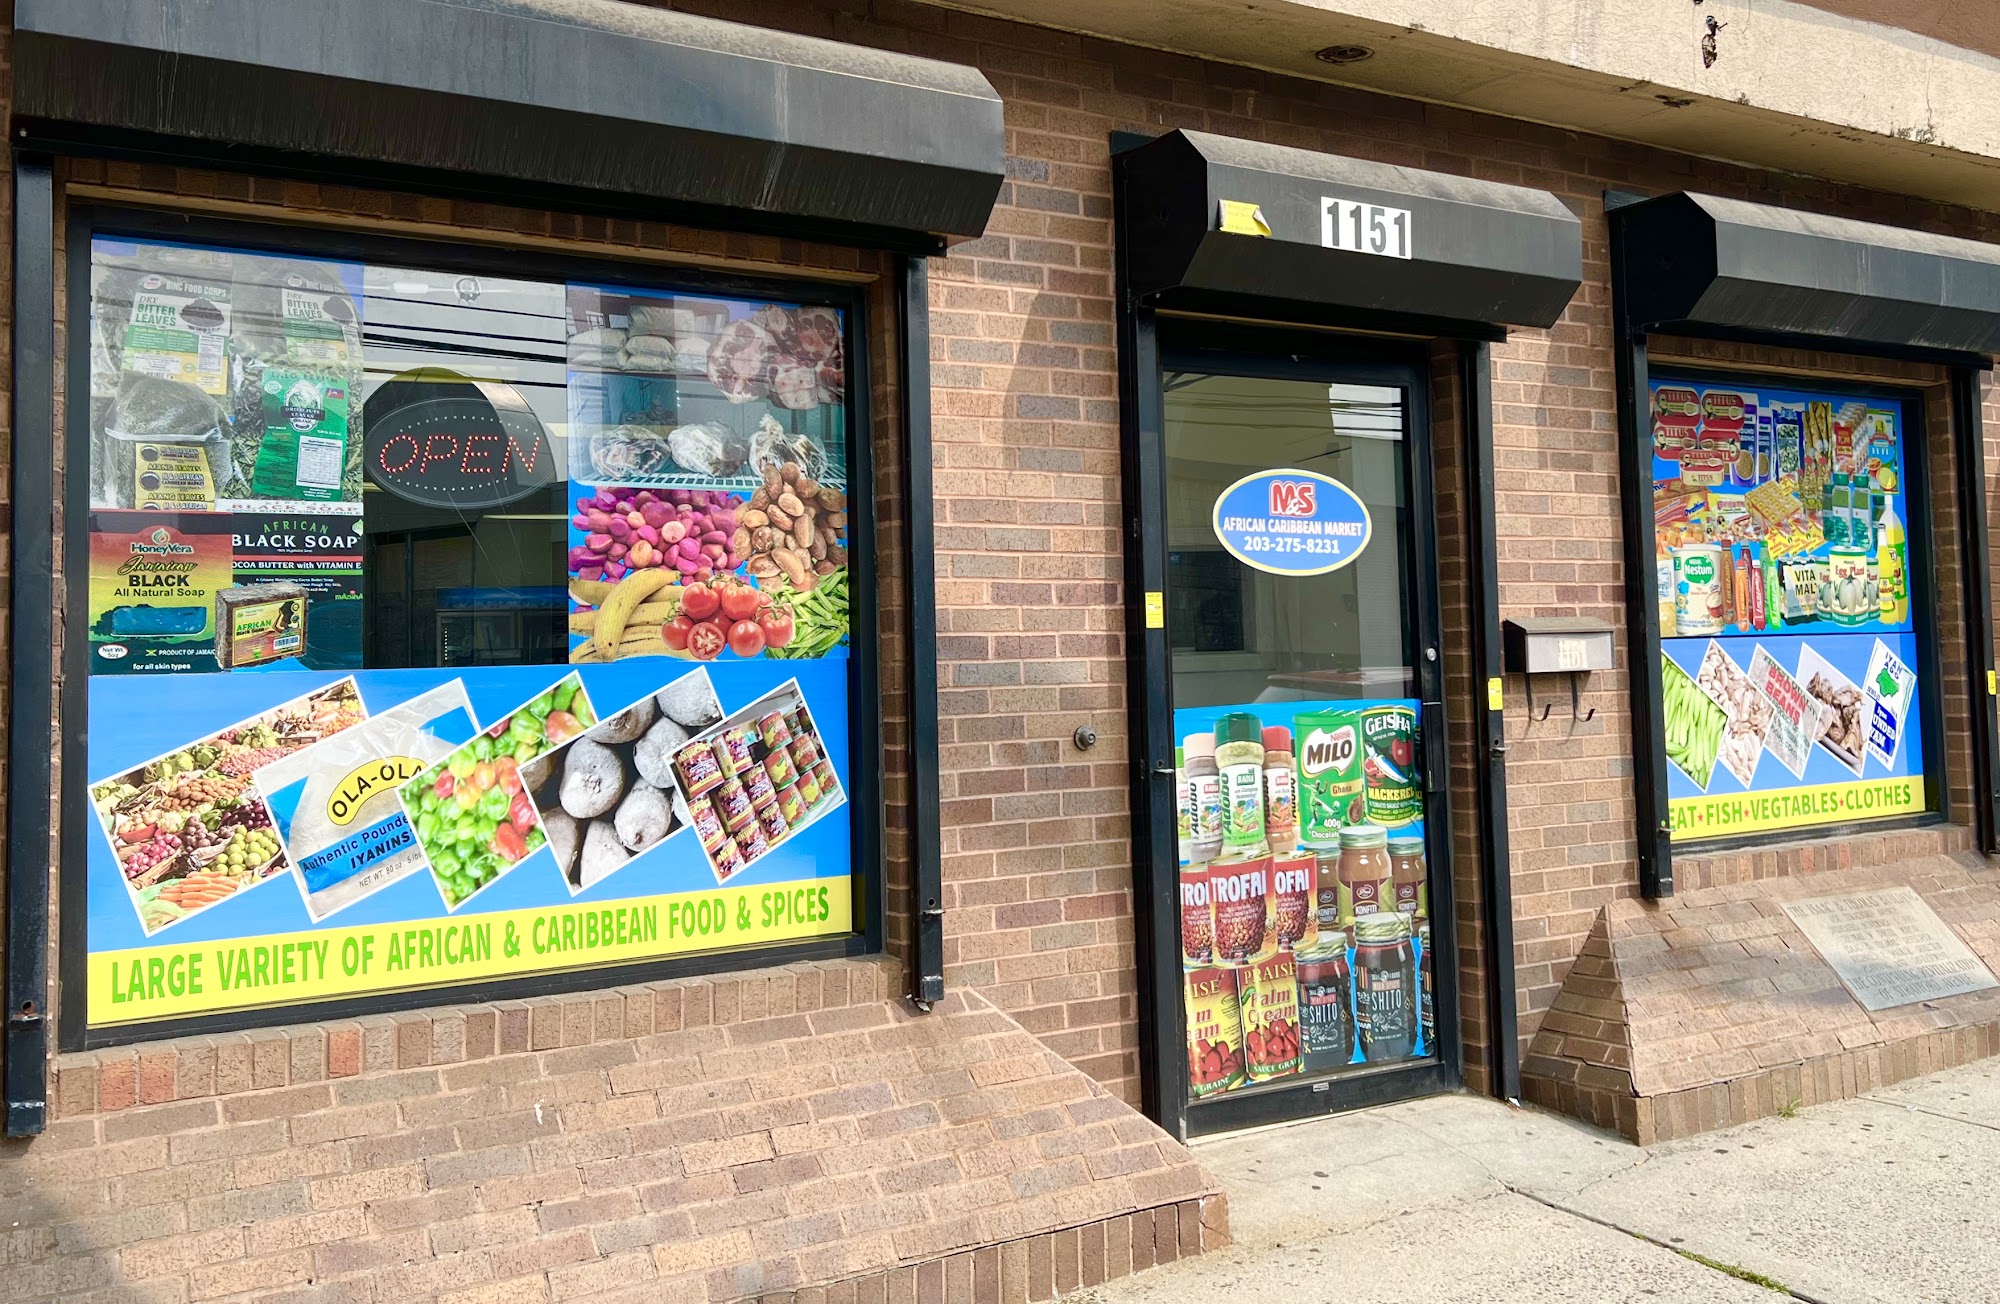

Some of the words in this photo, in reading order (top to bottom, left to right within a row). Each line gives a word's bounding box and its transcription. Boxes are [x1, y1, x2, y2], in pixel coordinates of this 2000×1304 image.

[1327, 201, 1406, 257] 1151
[139, 296, 159, 304] DRY
[184, 284, 202, 294] FOOD
[204, 286, 227, 298] CORPS
[286, 292, 302, 300] DRY
[137, 304, 176, 316] BITTER
[287, 299, 320, 311] BITTER
[288, 308, 323, 319] LEAVES
[135, 314, 177, 327] LEAVES
[1668, 392, 1692, 401] TITUS
[1713, 396, 1737, 405] TITUS
[1665, 428, 1689, 437] TITUS
[380, 434, 540, 474] OPEN
[1269, 480, 1318, 518] M&S
[264, 520, 329, 535] AFRICAN
[1223, 516, 1266, 533] AFRICAN
[1268, 518, 1322, 535] CARIBBEAN
[1324, 521, 1363, 537] MARKET
[131, 543, 193, 555] HoneyVera
[232, 534, 296, 548] BLACK
[305, 536, 358, 549] SOAP
[1244, 536, 1341, 554] 203-275-8231
[118, 555, 198, 575] Jamaican
[1685, 564, 1713, 575] Nestum
[1836, 565, 1848, 578] Egg
[1850, 564, 1865, 576] Plant
[129, 574, 190, 587] BLACK
[1795, 570, 1816, 582] VITA
[1820, 572, 1830, 583] Egg
[114, 588, 129, 596] All
[133, 588, 174, 597] Natural
[177, 588, 205, 598] Soap
[236, 620, 272, 632] AFRICAN
[1884, 662, 1899, 680] ADO
[1885, 652, 1903, 675] IYAN
[1768, 666, 1807, 712] BROWN
[1765, 680, 1801, 726] BEANS
[1365, 714, 1411, 736] GEISHA
[1872, 714, 1896, 741] UNDED
[1870, 727, 1887, 748] YAM
[1306, 739, 1353, 766] MILO
[1332, 785, 1352, 795] Ghana
[1368, 786, 1414, 801] MACKEREL
[1668, 806, 1697, 830] EAT
[1706, 800, 1743, 826] FISH
[1750, 791, 1839, 821] VEGTABLES
[1846, 784, 1911, 811] CLOTHES
[1324, 818, 1341, 829] 400g
[1312, 830, 1340, 838] Chocolat
[304, 840, 359, 872] Authentic
[362, 815, 409, 844] Pounde
[350, 830, 413, 869] IYANINS
[359, 876, 372, 888] NET
[374, 870, 385, 881] WT.
[412, 852, 424, 862] lbs.
[1210, 870, 1267, 903] TROFAI
[1274, 868, 1310, 895] OFAI
[1787, 906, 1809, 917] THE
[1806, 902, 1835, 915] ISAAC
[1843, 896, 1879, 910] THOMAS
[1878, 890, 1920, 906] BUILDING
[112, 952, 203, 1004] LARGE
[217, 939, 330, 991] VARIETY
[341, 935, 375, 977] OF
[386, 922, 491, 972] AFRICAN
[503, 920, 521, 958] &
[532, 906, 658, 955] CARIBBEAN
[670, 898, 726, 939] FOOD
[736, 895, 751, 930] &
[761, 886, 830, 929] SPICES
[1244, 962, 1296, 985] PRAISE
[1847, 976, 1869, 990] THE
[1865, 968, 1920, 987] CONTINUING
[1917, 958, 1980, 979] REVITALIZATION
[1184, 980, 1220, 998] ISE
[1878, 988, 1894, 1000] OF
[1893, 980, 1942, 998] STRATFORD
[1942, 974, 1976, 989] AVENUE
[1251, 989, 1291, 1008] Palm
[1372, 989, 1402, 1011] SHITO
[1309, 1002, 1338, 1024] SHITO
[1187, 1024, 1220, 1041] eam
[1254, 1064, 1276, 1073] SAUCE
